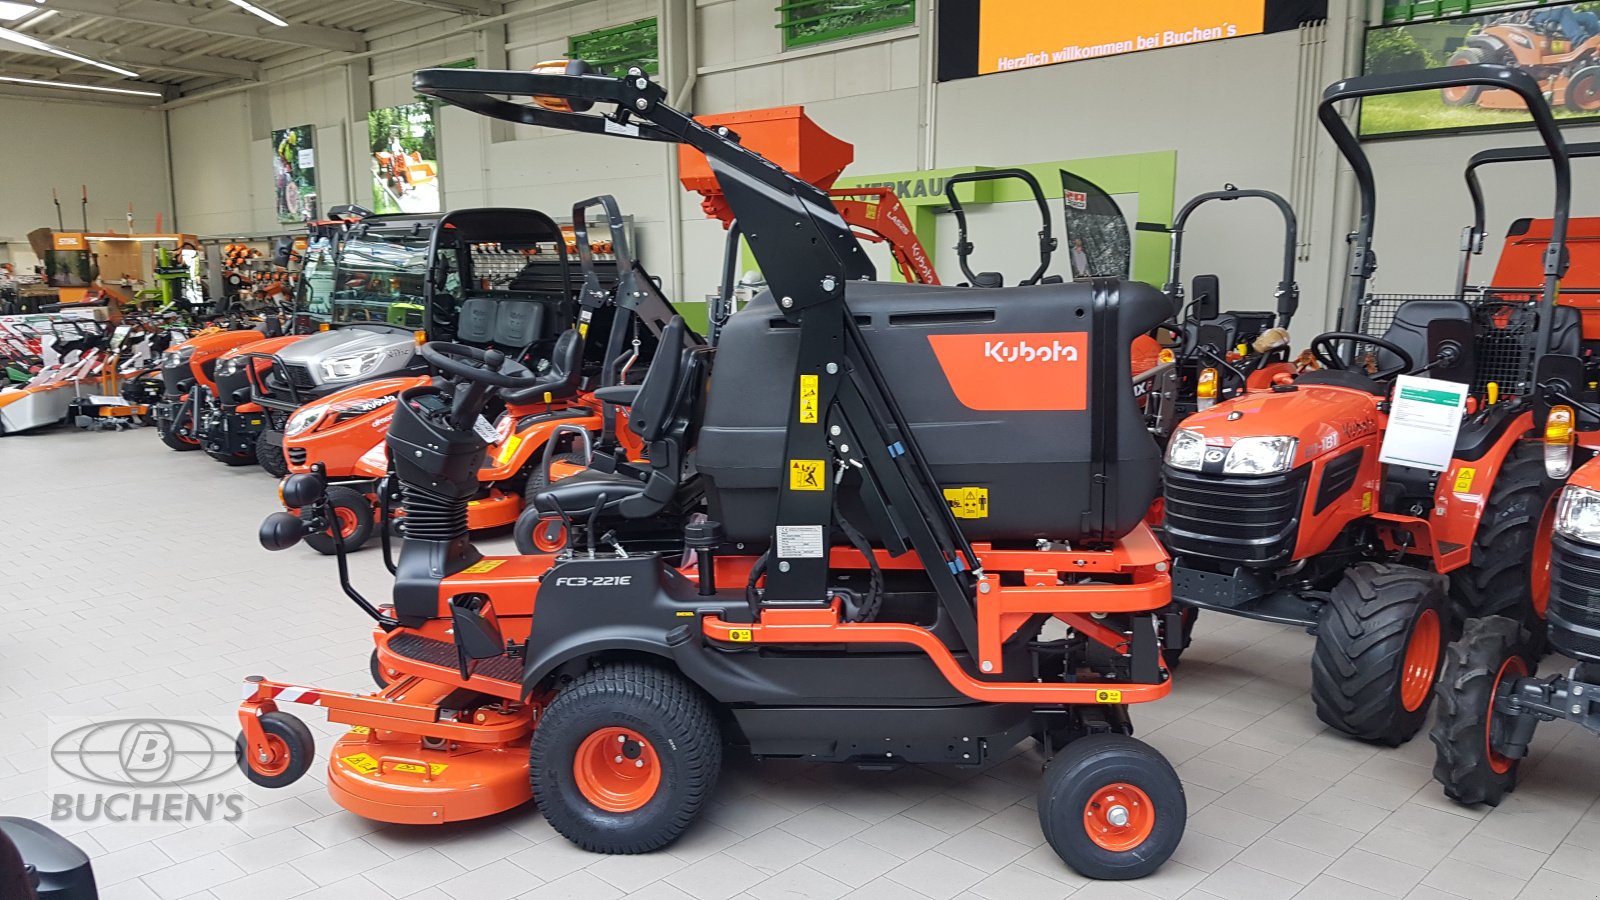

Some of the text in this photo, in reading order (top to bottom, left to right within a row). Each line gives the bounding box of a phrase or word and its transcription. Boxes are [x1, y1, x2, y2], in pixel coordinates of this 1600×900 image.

[997, 51, 1050, 72] Herzlich
[1052, 41, 1133, 64] willkommen
[1136, 33, 1160, 49] bei
[911, 242, 935, 284] Kubota
[984, 340, 1078, 363] Kubota
[361, 395, 397, 411] Kubota
[555, 575, 632, 587] FC3-221E
